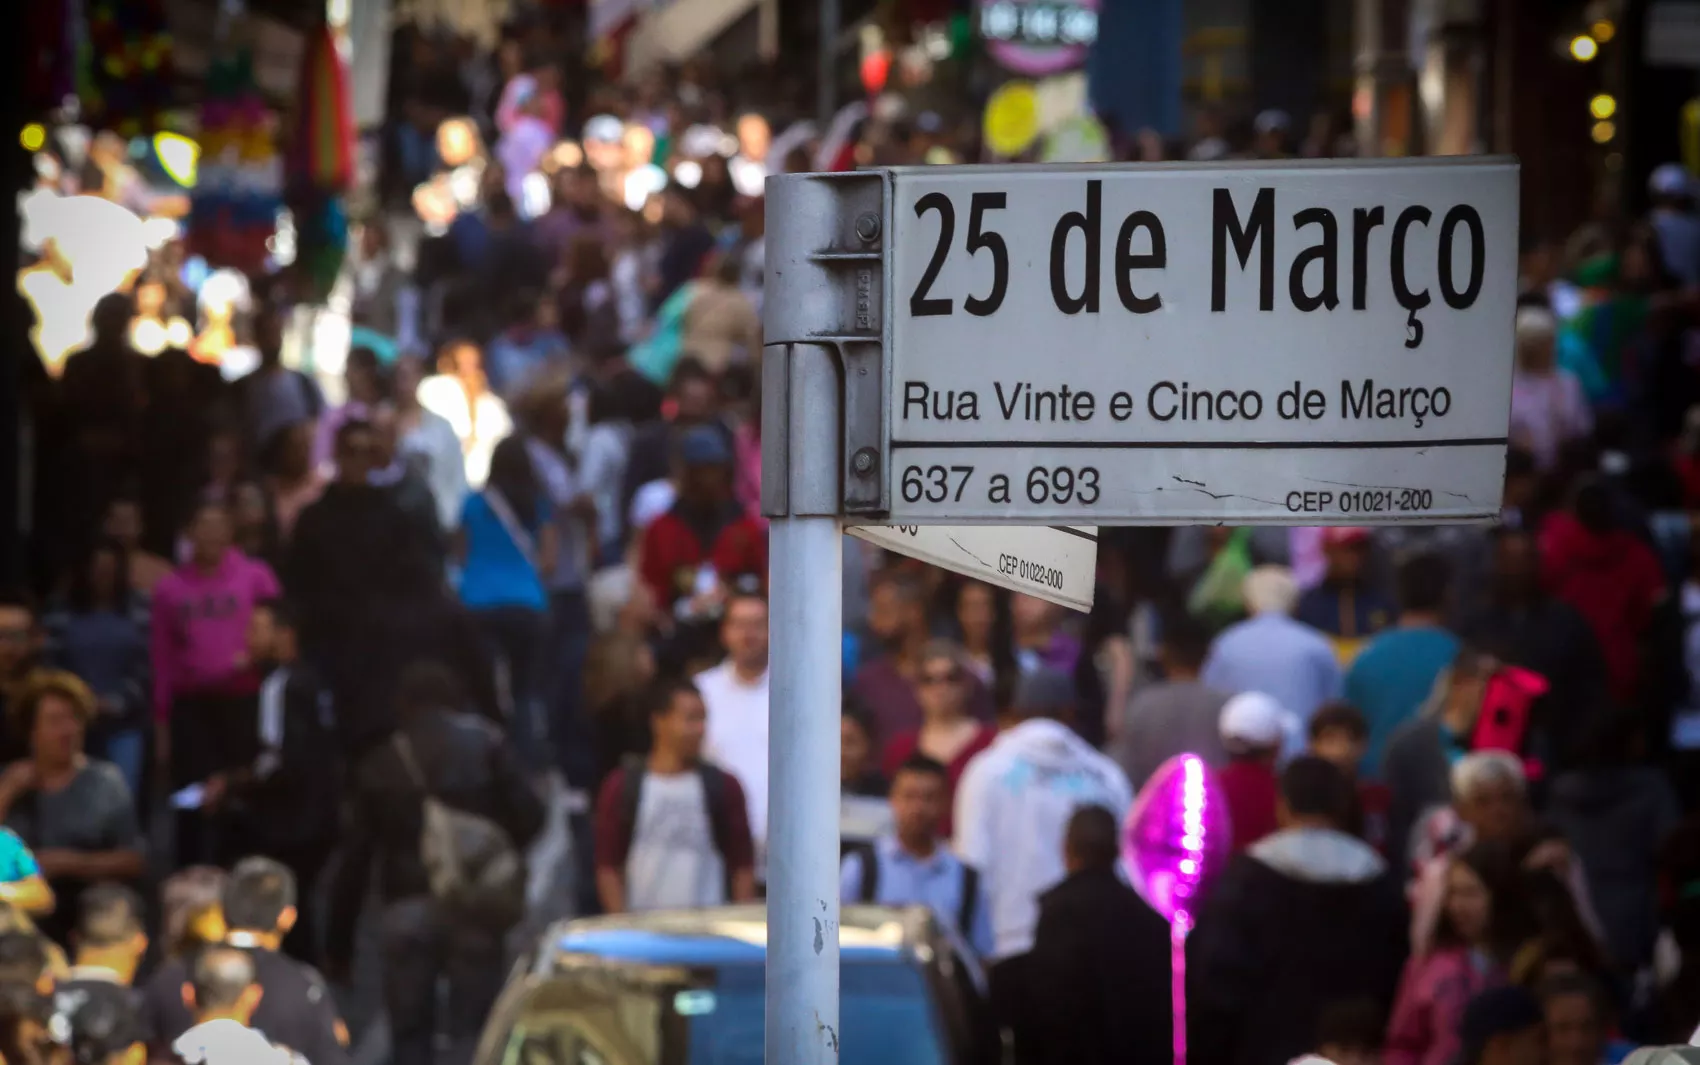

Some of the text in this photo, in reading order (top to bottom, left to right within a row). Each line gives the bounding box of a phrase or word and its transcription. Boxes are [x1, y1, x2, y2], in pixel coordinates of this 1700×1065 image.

[910, 180, 1486, 349] 25 de Março
[902, 378, 1452, 429] Rua Vinte e Cinco de Março
[901, 465, 1101, 506] 637 a 693
[1286, 489, 1433, 512] CEP 01021-200
[999, 553, 1063, 590] CEP 01022-000
